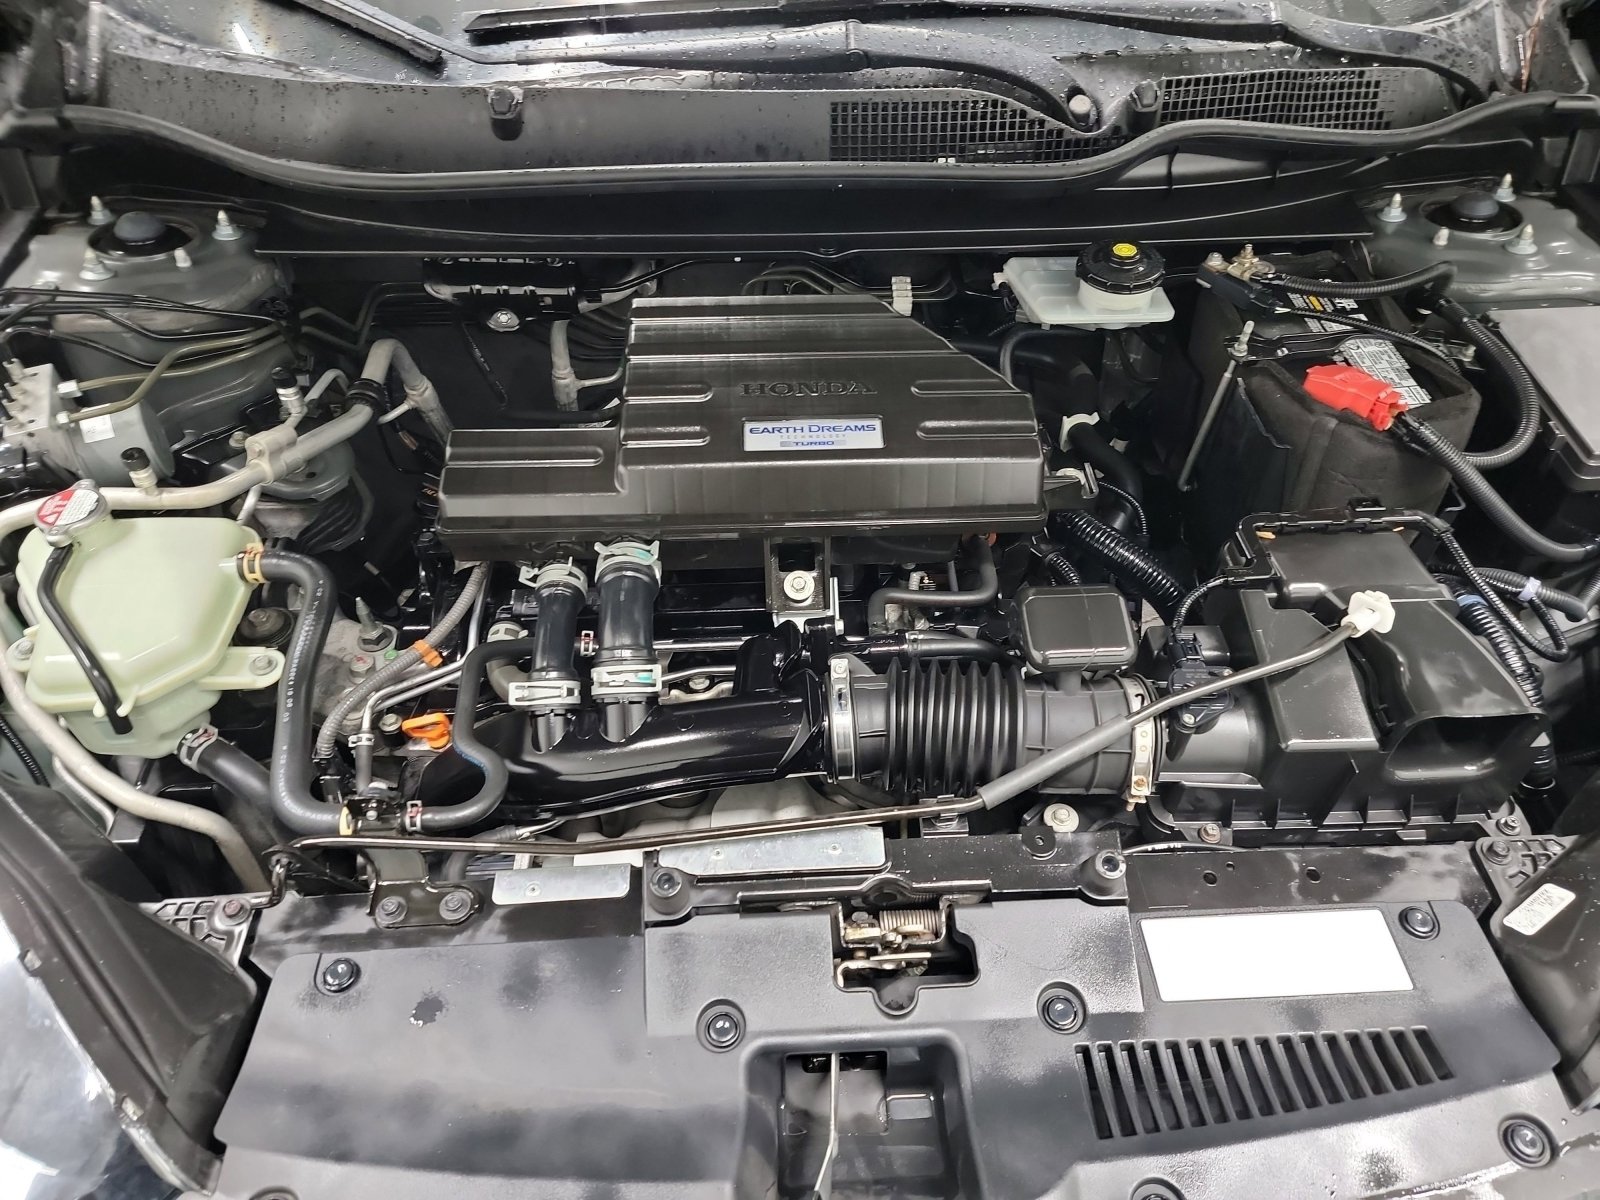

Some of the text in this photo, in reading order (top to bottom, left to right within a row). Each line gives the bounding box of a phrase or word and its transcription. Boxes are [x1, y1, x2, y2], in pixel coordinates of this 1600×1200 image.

[741, 381, 878, 396] HONDA
[749, 424, 876, 435] EARTH DREAMS
